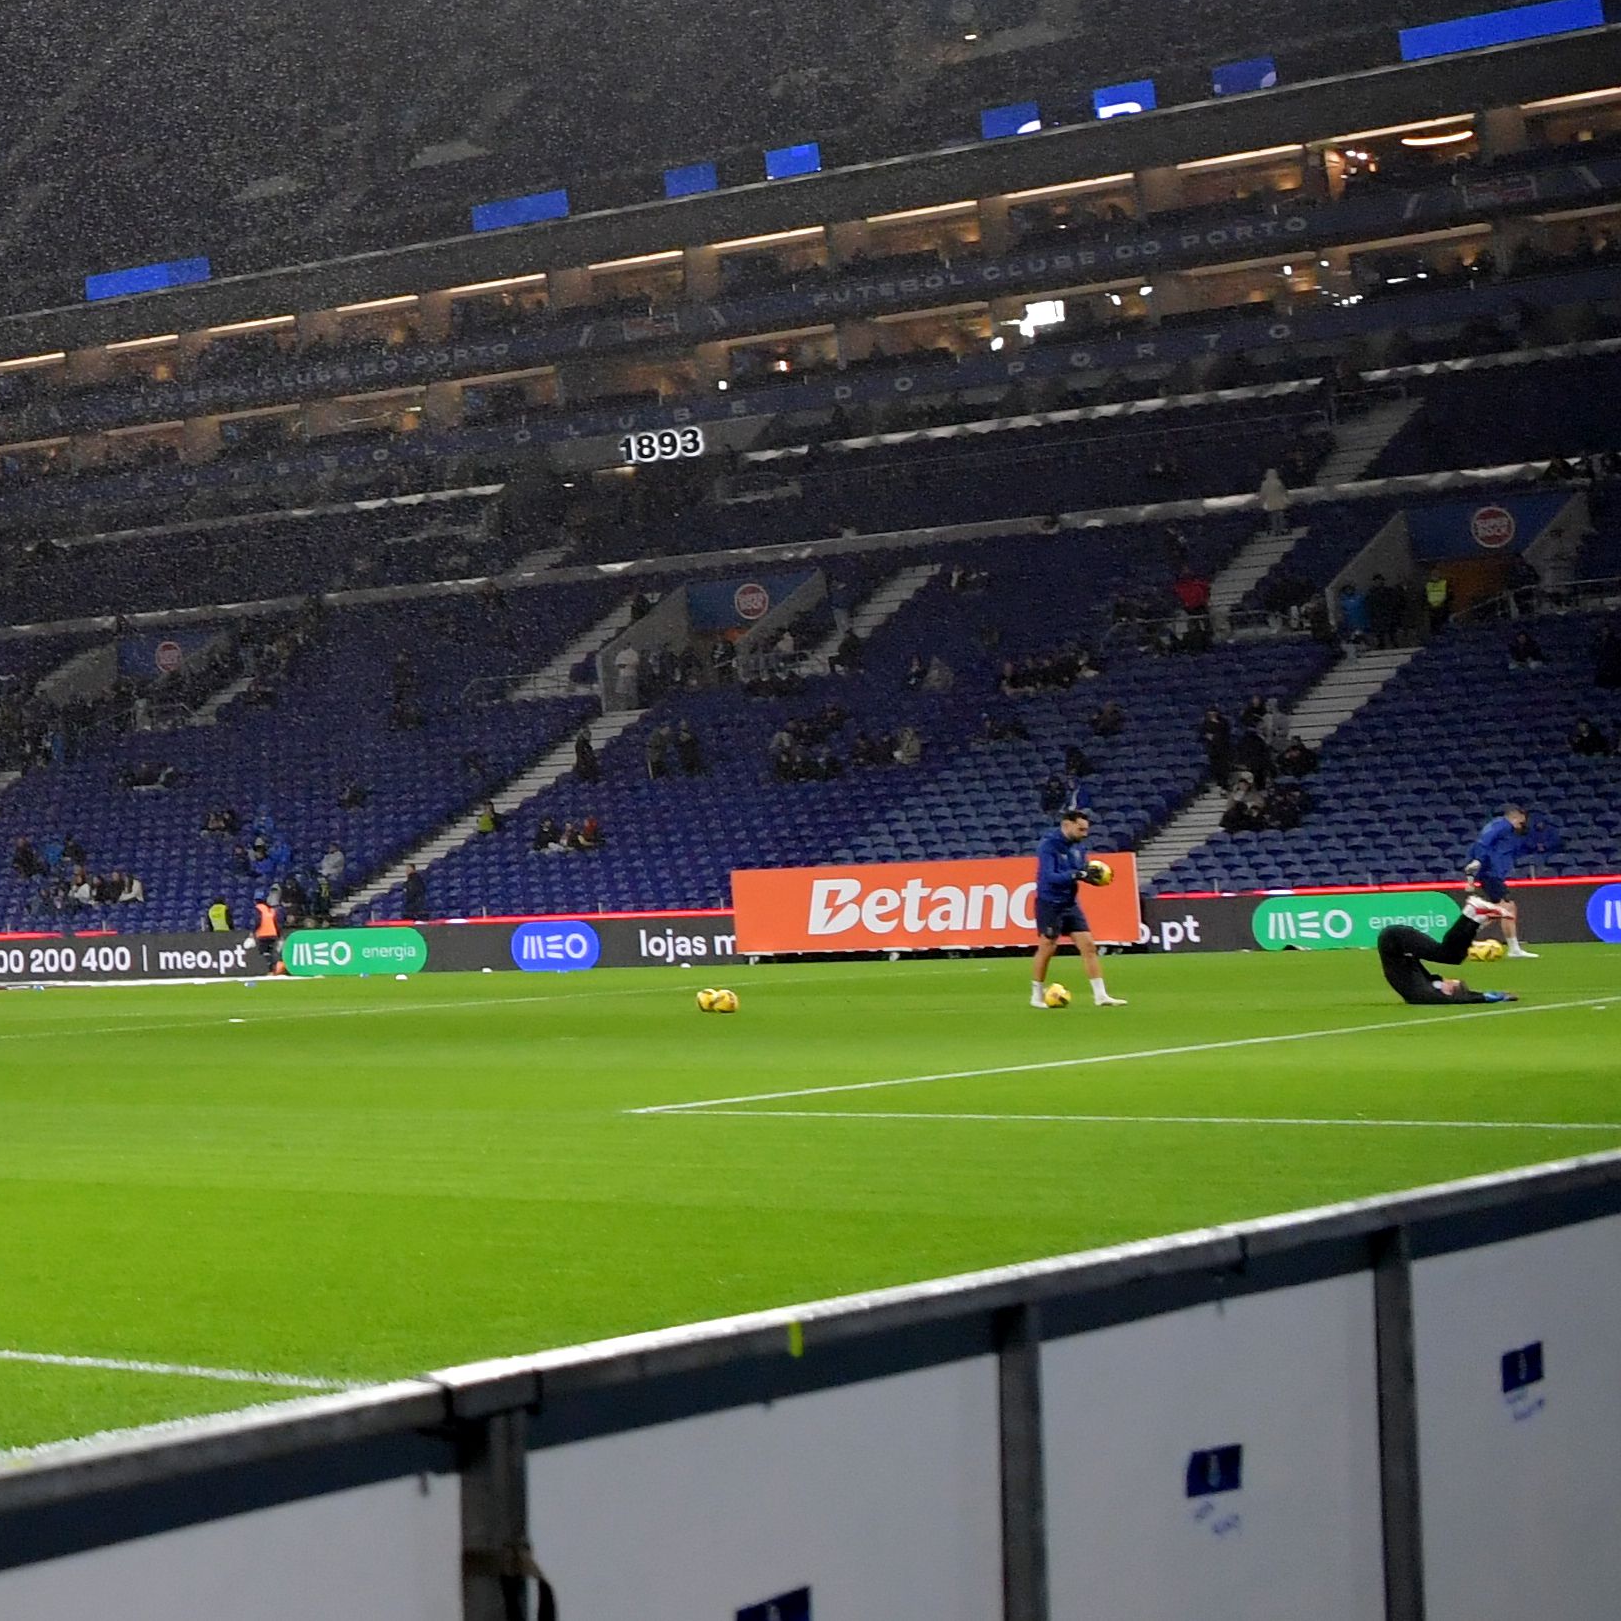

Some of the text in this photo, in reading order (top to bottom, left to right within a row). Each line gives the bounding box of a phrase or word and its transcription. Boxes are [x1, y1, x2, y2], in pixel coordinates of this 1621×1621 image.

[812, 274, 964, 306] FUTEBOL
[1180, 216, 1307, 249] PORTO
[619, 427, 703, 462] 1893
[807, 876, 1037, 936] Betano
[1268, 910, 1448, 939] MEO energia
[29, 948, 77, 973] 200
[81, 946, 131, 971] 400
[159, 944, 246, 973] meo.pt
[292, 941, 416, 966] MEO energia
[522, 933, 587, 960] MEO
[639, 929, 707, 963] lojas
